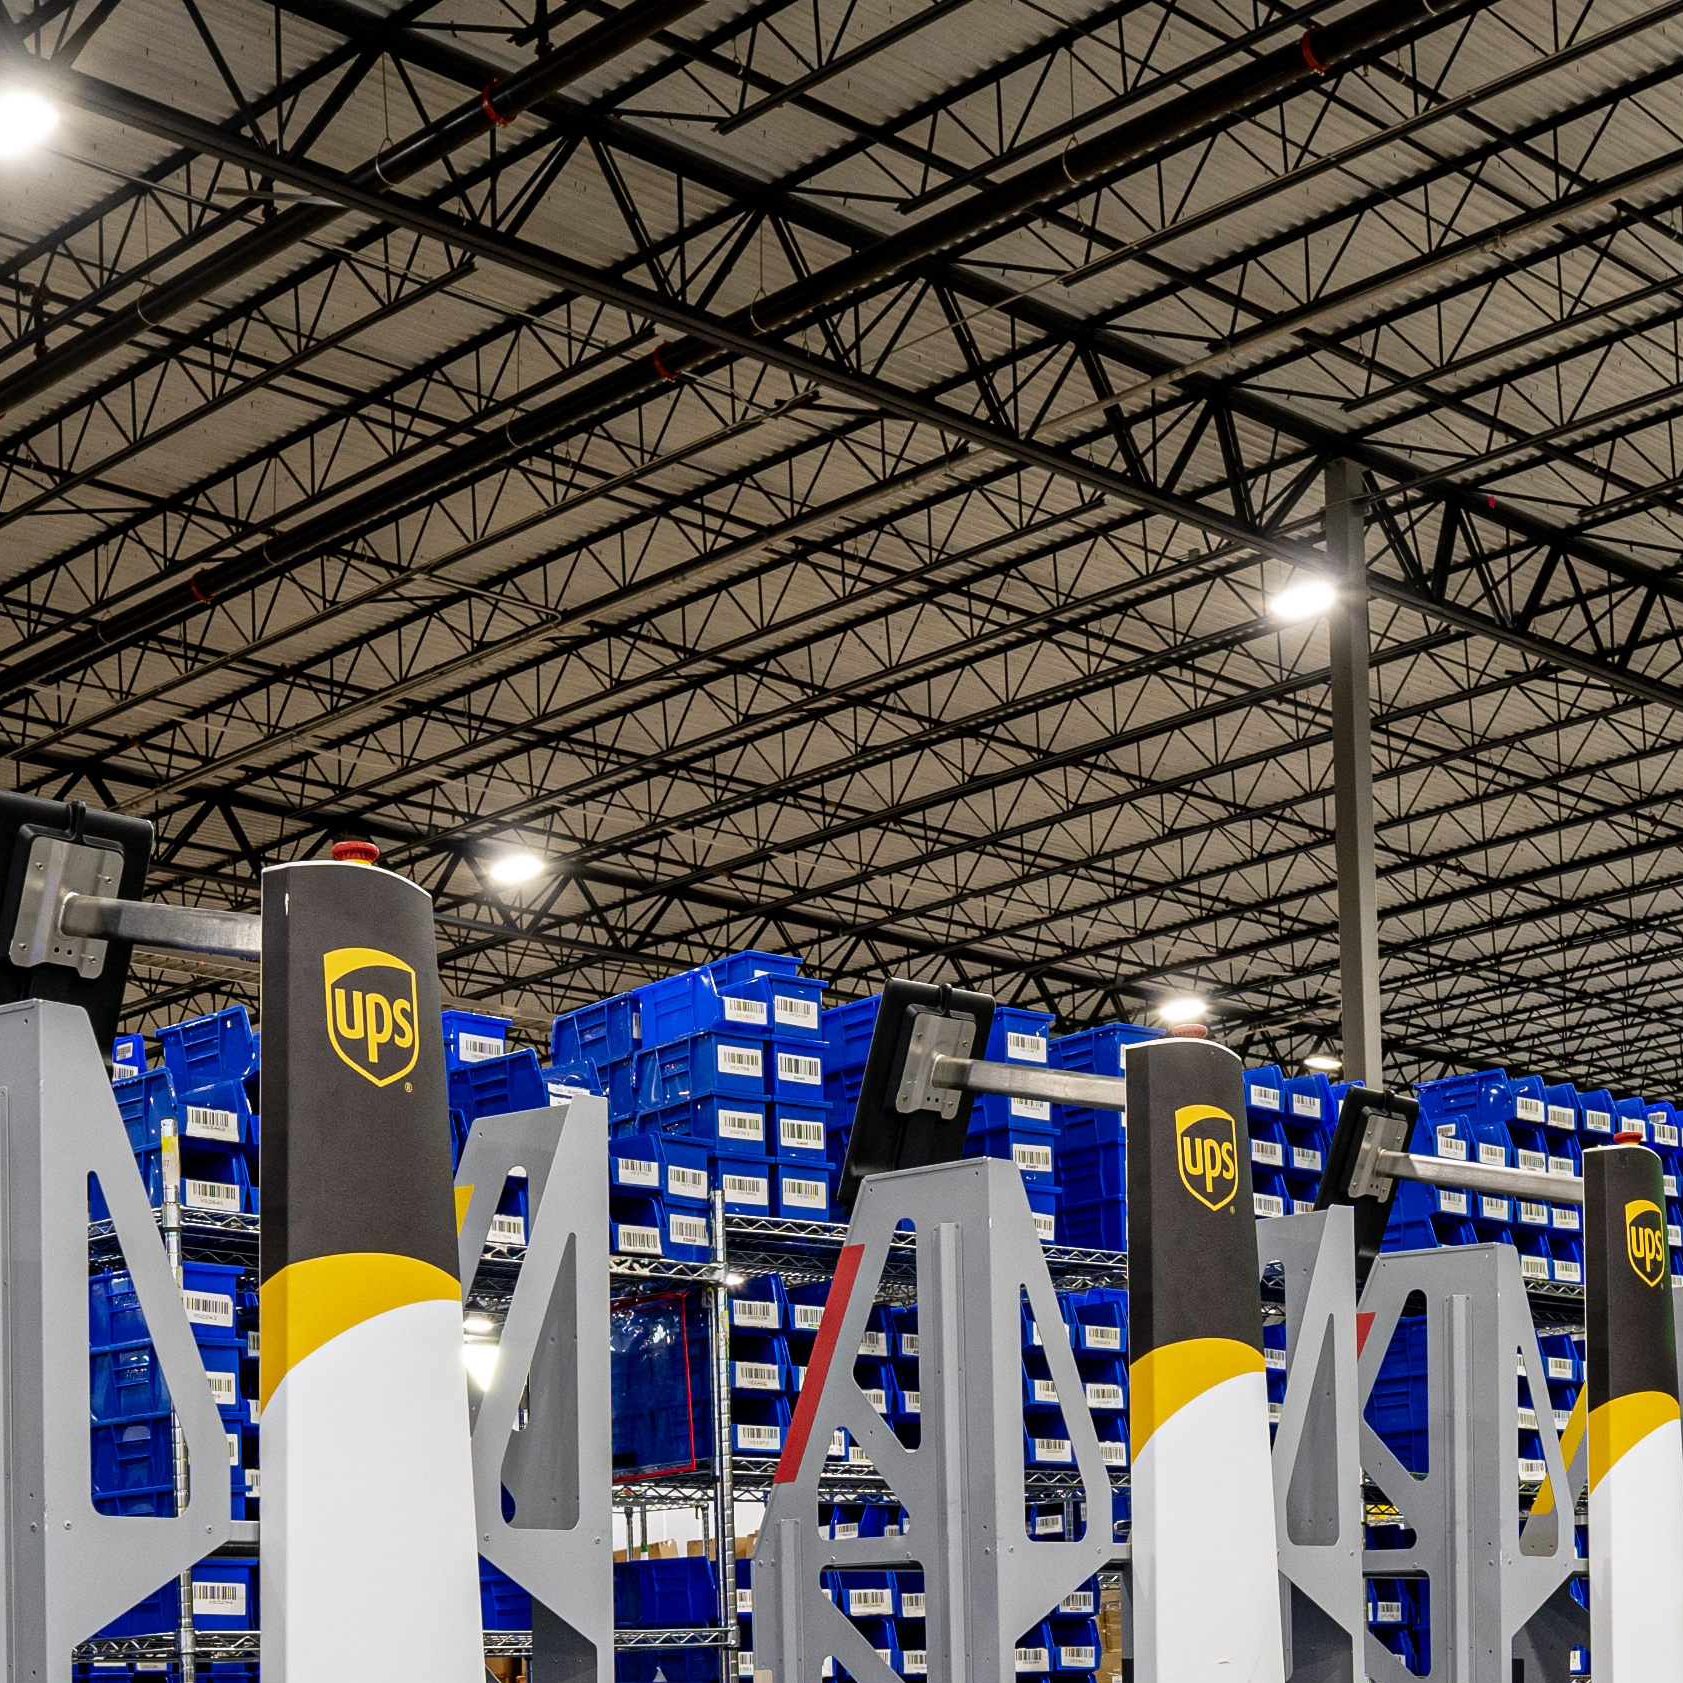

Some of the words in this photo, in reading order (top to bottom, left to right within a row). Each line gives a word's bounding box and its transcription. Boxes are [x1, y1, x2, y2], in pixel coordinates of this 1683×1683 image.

[335, 988, 413, 1063] ups
[1182, 1136, 1234, 1193] ups
[1631, 1225, 1663, 1272] ups
